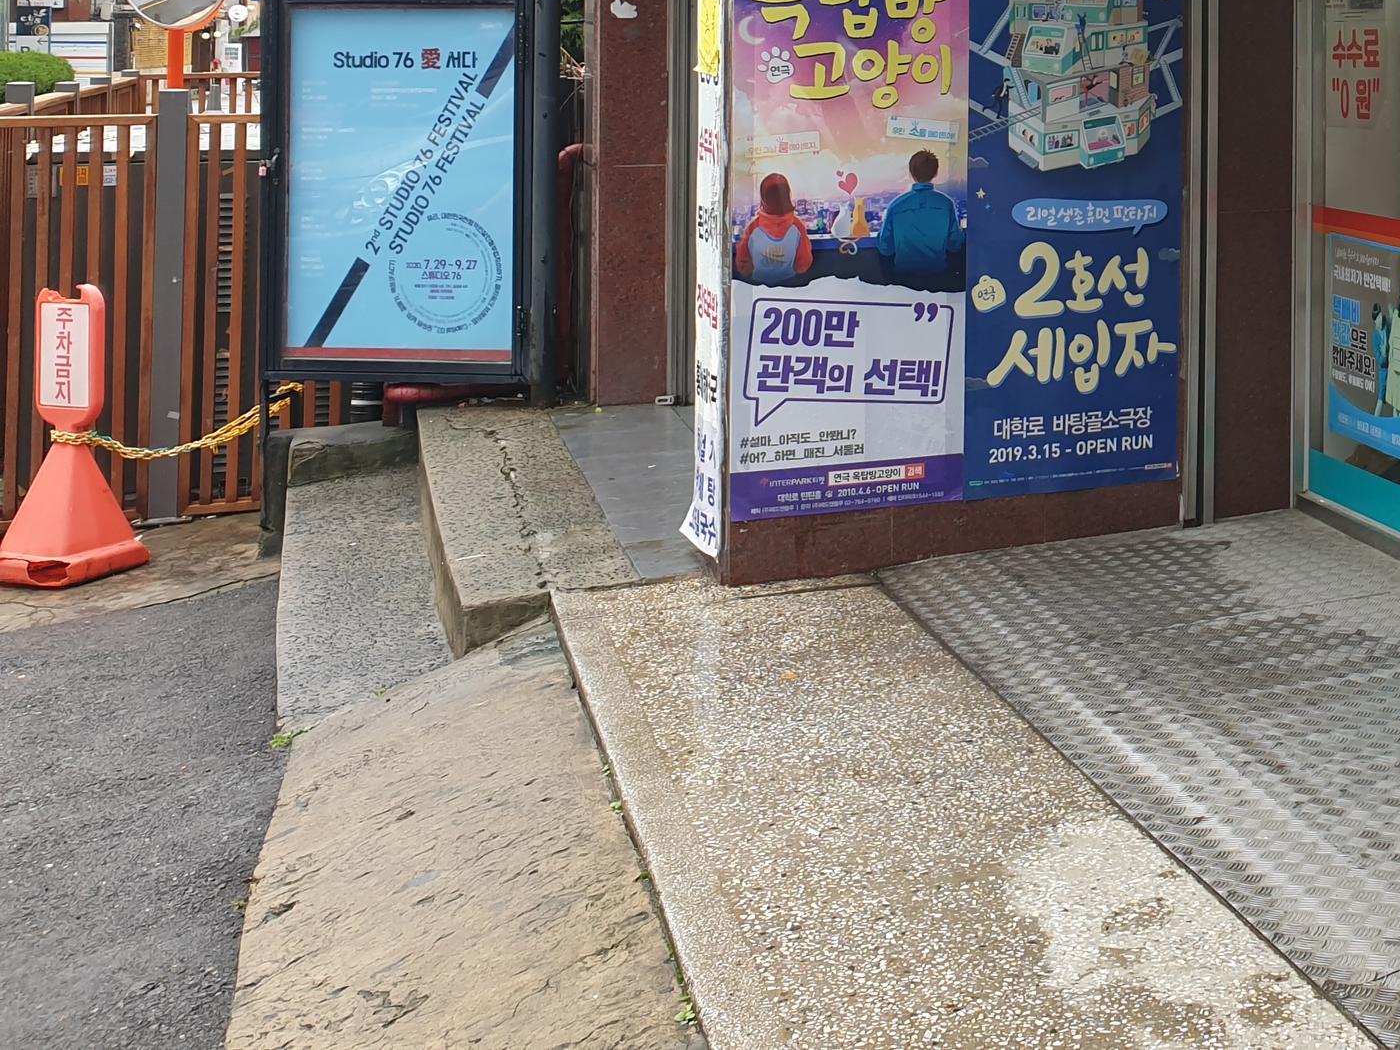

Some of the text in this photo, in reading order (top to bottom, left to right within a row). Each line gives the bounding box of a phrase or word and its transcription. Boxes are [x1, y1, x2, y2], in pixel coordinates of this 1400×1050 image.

[333, 51, 389, 69] Studio
[393, 52, 414, 68] 76
[1332, 29, 1380, 68] 수수료
[770, 65, 790, 76] 연극
[790, 39, 953, 109] 고양이
[365, 71, 477, 254] 2nd STUDIO 76 FESTIVAL
[389, 100, 485, 254] STUDIO 76 FESTIVAL
[1114, 205, 1157, 222] 판타지
[451, 271, 461, 280] 76
[977, 285, 997, 302] 연극
[1014, 241, 1151, 319] 2호선
[760, 307, 859, 348] 200만
[54, 306, 73, 405] 주차금지
[986, 319, 1177, 394] 세입자
[756, 355, 854, 394] 관객의
[863, 358, 942, 398] 선택!
[994, 407, 1152, 440] 대학로 바탕골소극장
[989, 434, 1153, 464] 2019.3.15 OPEN RUN
[833, 467, 900, 483] 연극 옥탑방고양이
[901, 482, 919, 491] RUN
